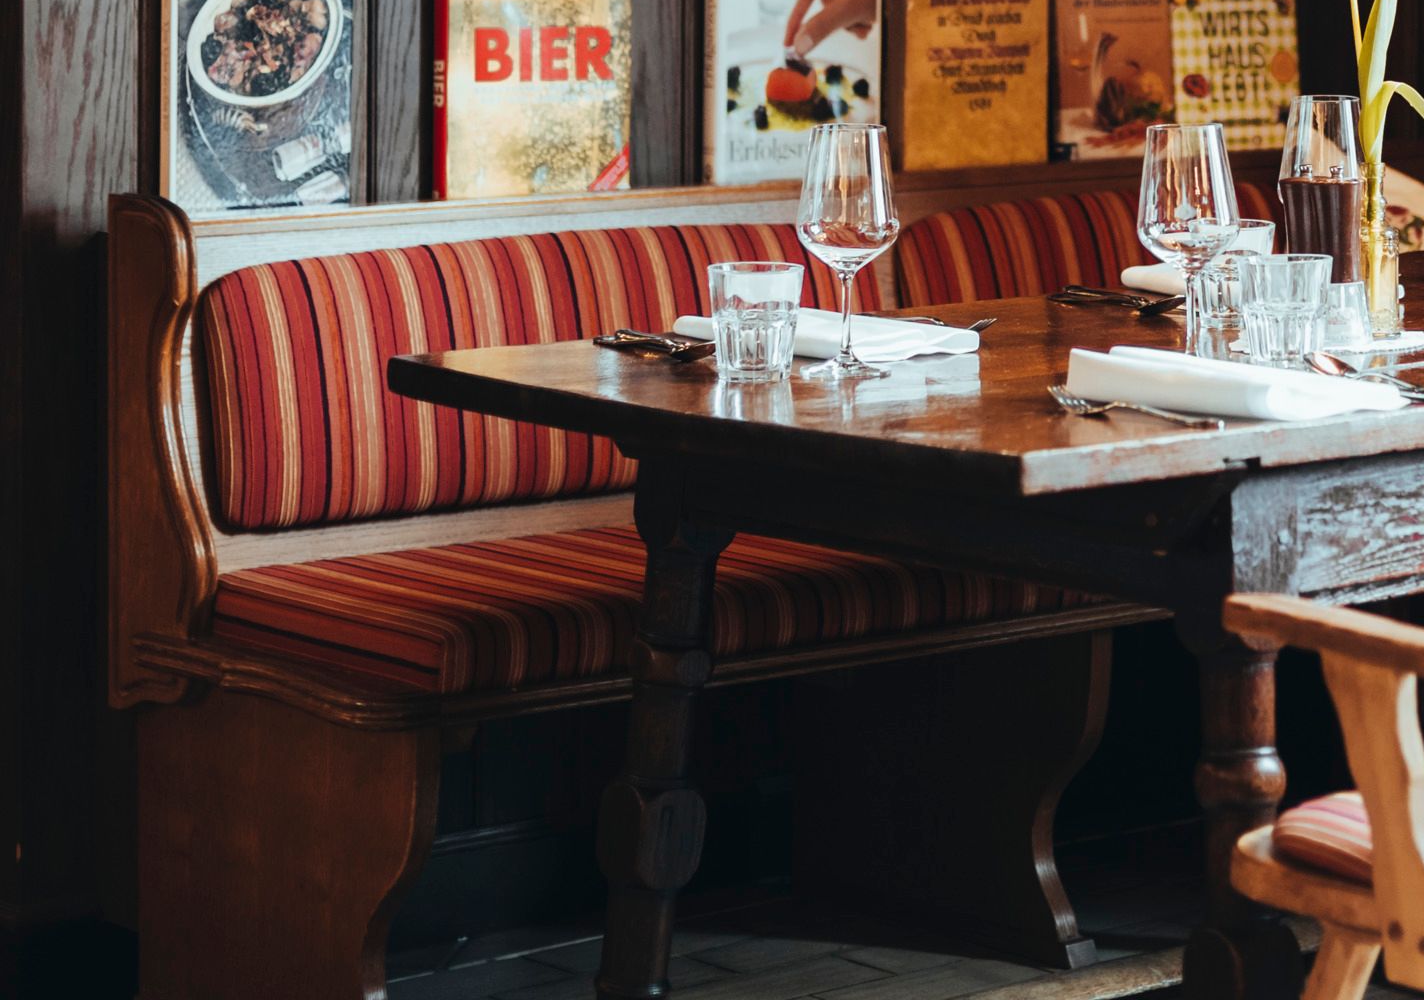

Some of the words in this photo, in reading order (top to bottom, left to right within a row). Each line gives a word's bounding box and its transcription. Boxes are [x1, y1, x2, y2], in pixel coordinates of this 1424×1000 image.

[1201, 9, 1270, 37] WIRTS
[473, 24, 615, 83] BIER
[1207, 43, 1266, 70] HAUS
[432, 59, 445, 108] BIER
